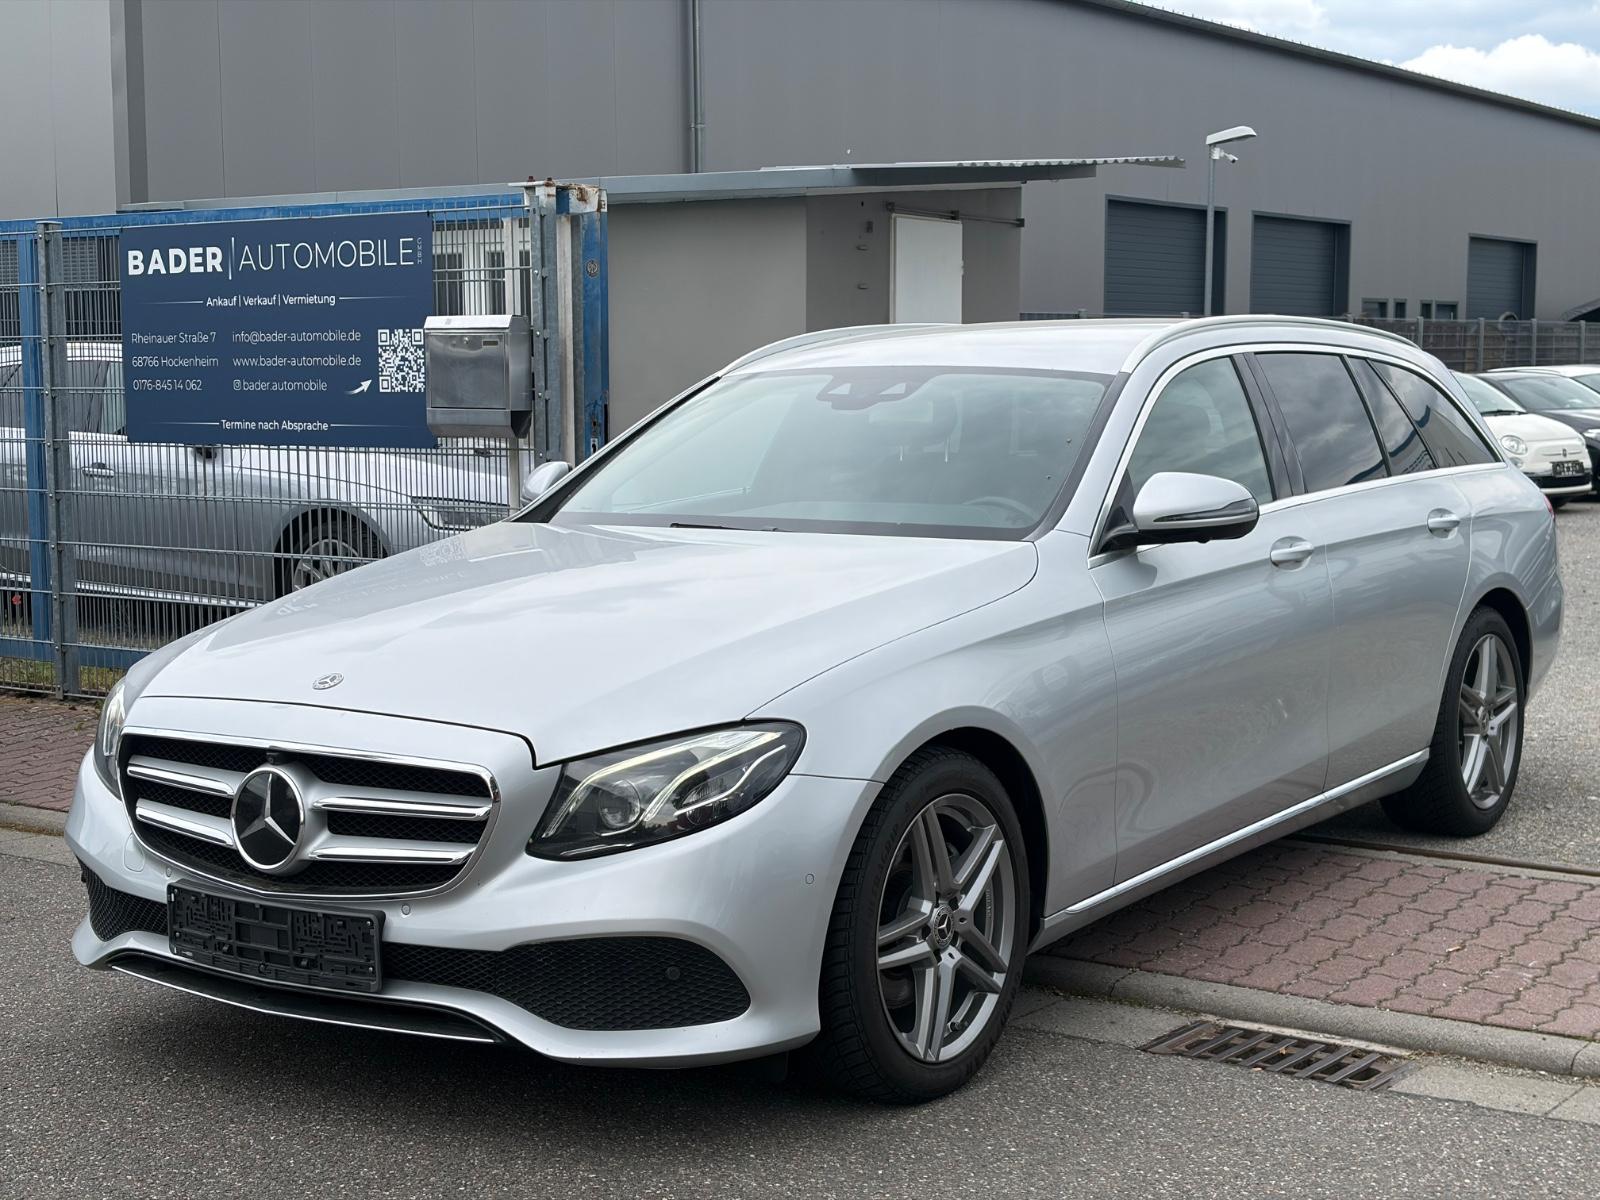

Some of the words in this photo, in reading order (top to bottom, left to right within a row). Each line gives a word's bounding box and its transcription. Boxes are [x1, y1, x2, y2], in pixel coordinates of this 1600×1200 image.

[127, 246, 223, 276] BADER
[239, 237, 415, 271] AUTOMOBILE
[206, 295, 237, 307] Ankauf
[243, 294, 278, 306] Verkauf
[282, 293, 336, 306] Vermietung
[131, 332, 177, 344] Rheinauer
[178, 331, 209, 343] Straße
[209, 331, 217, 342] 7
[232, 329, 361, 345] info@bader-automobile.de
[132, 355, 160, 367] 68766
[161, 355, 219, 367] Hockenheim
[232, 354, 362, 367] www.bader-automobile.de
[185, 379, 202, 391] 062
[220, 419, 257, 430] Termine
[258, 420, 280, 430] nach
[281, 420, 329, 432] Absprache
